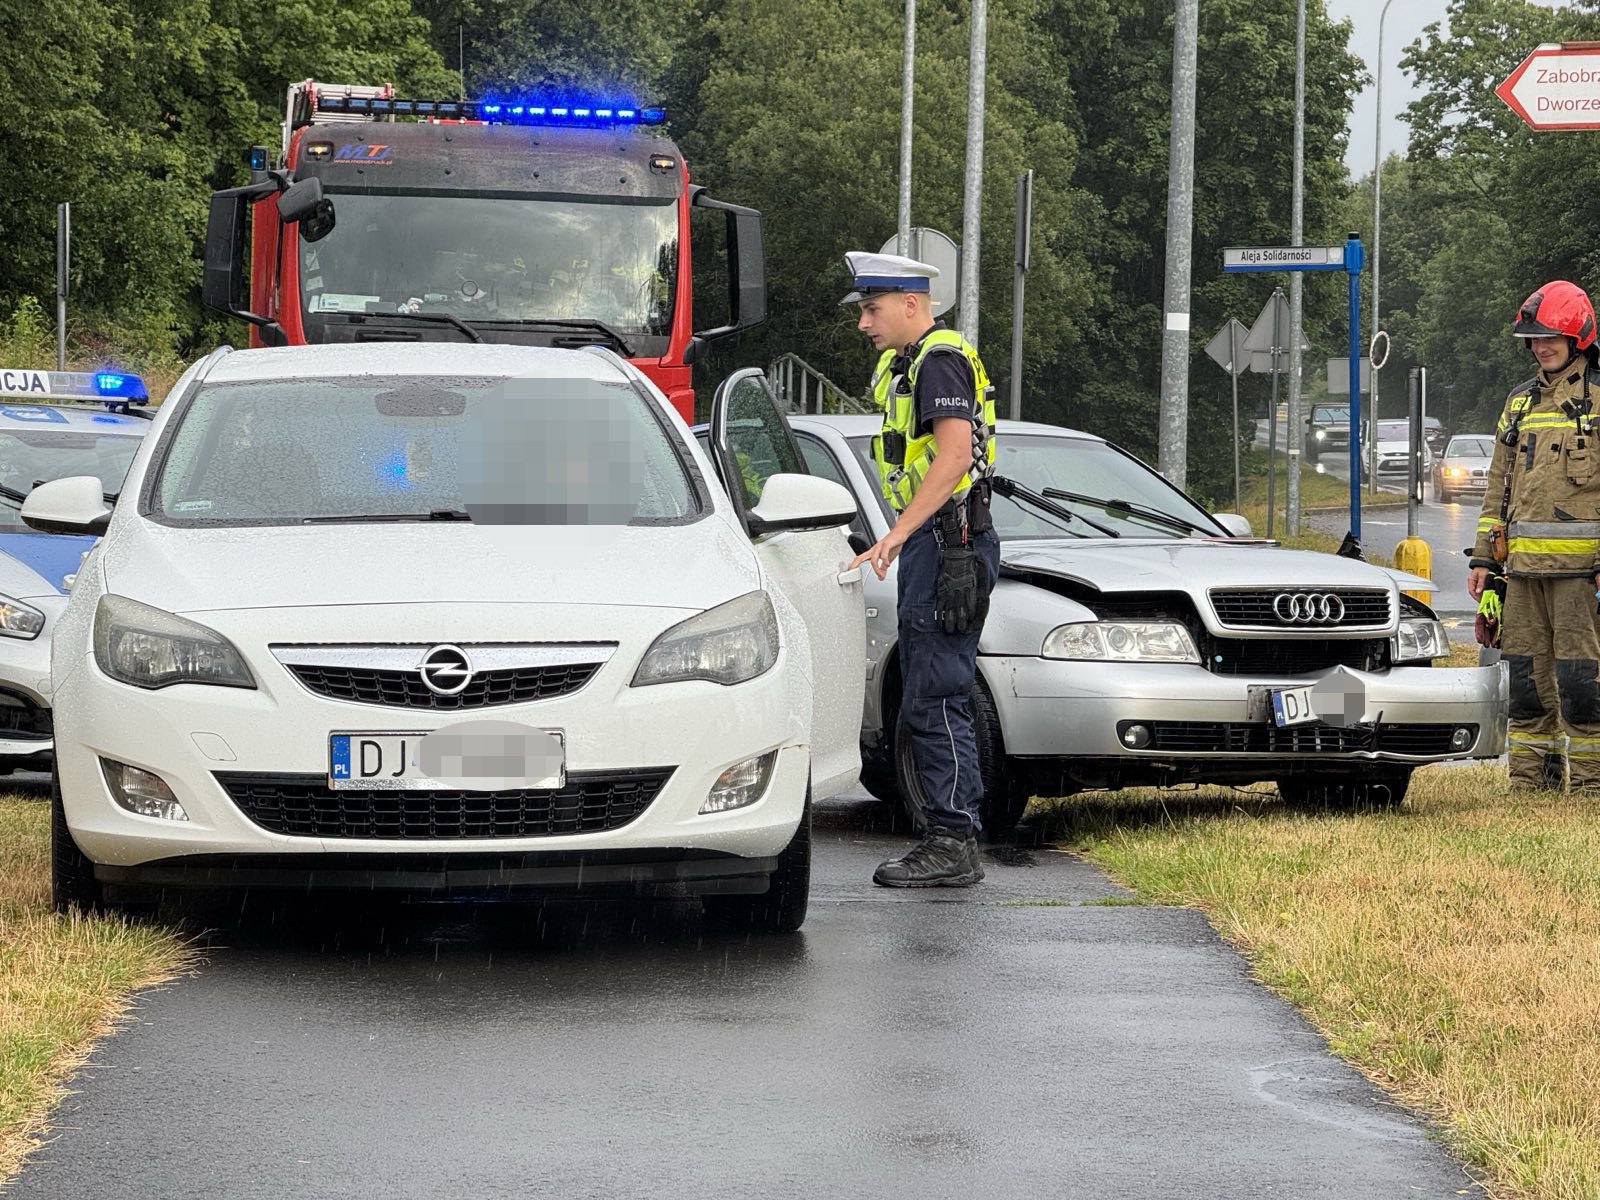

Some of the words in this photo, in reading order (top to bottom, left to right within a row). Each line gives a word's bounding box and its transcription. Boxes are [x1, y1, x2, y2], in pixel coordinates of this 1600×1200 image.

[1240, 251, 1261, 263] Aleja
[1262, 249, 1312, 261] Solidarności
[934, 397, 969, 409] POLICJA
[334, 764, 348, 775] PL
